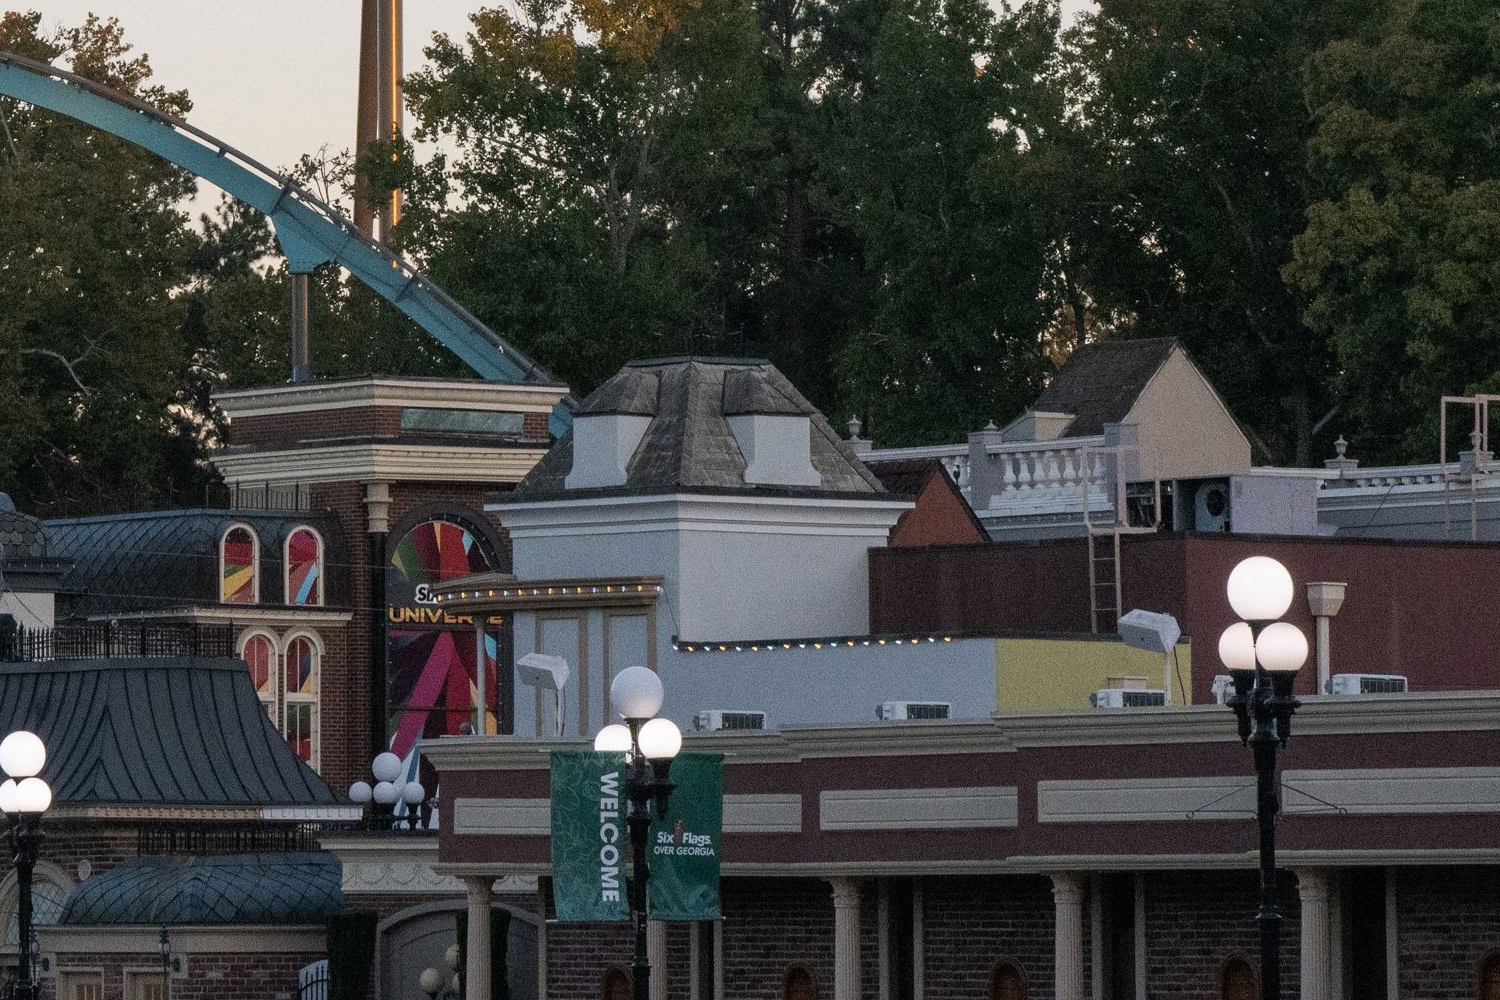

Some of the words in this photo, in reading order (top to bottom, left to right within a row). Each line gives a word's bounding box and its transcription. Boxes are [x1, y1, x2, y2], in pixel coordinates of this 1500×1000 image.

[600, 771, 619, 902] WELCOME
[657, 831, 675, 844] Six
[682, 832, 711, 847] Flags
[653, 846, 675, 855] OVER
[676, 846, 715, 857] GEORGIA
